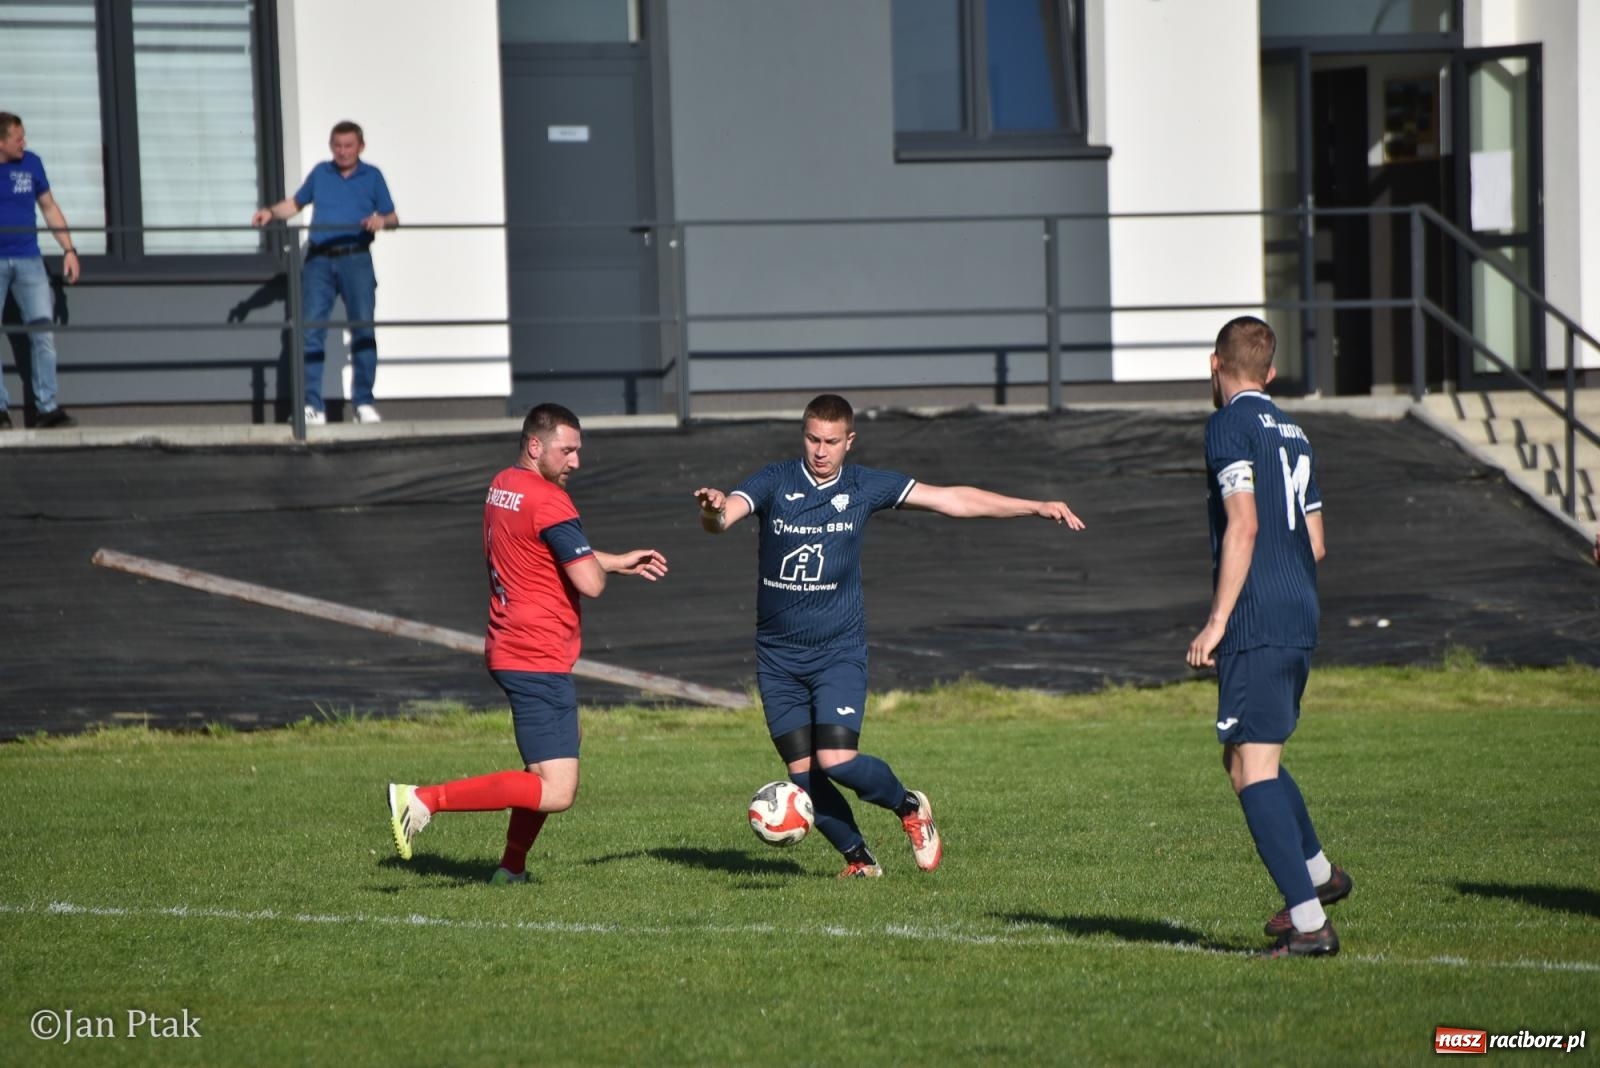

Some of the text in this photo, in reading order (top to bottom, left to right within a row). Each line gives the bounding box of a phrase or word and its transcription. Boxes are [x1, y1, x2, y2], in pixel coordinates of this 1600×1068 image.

[783, 522, 854, 534] MASTER GSM
[763, 578, 802, 591] Bauservice
